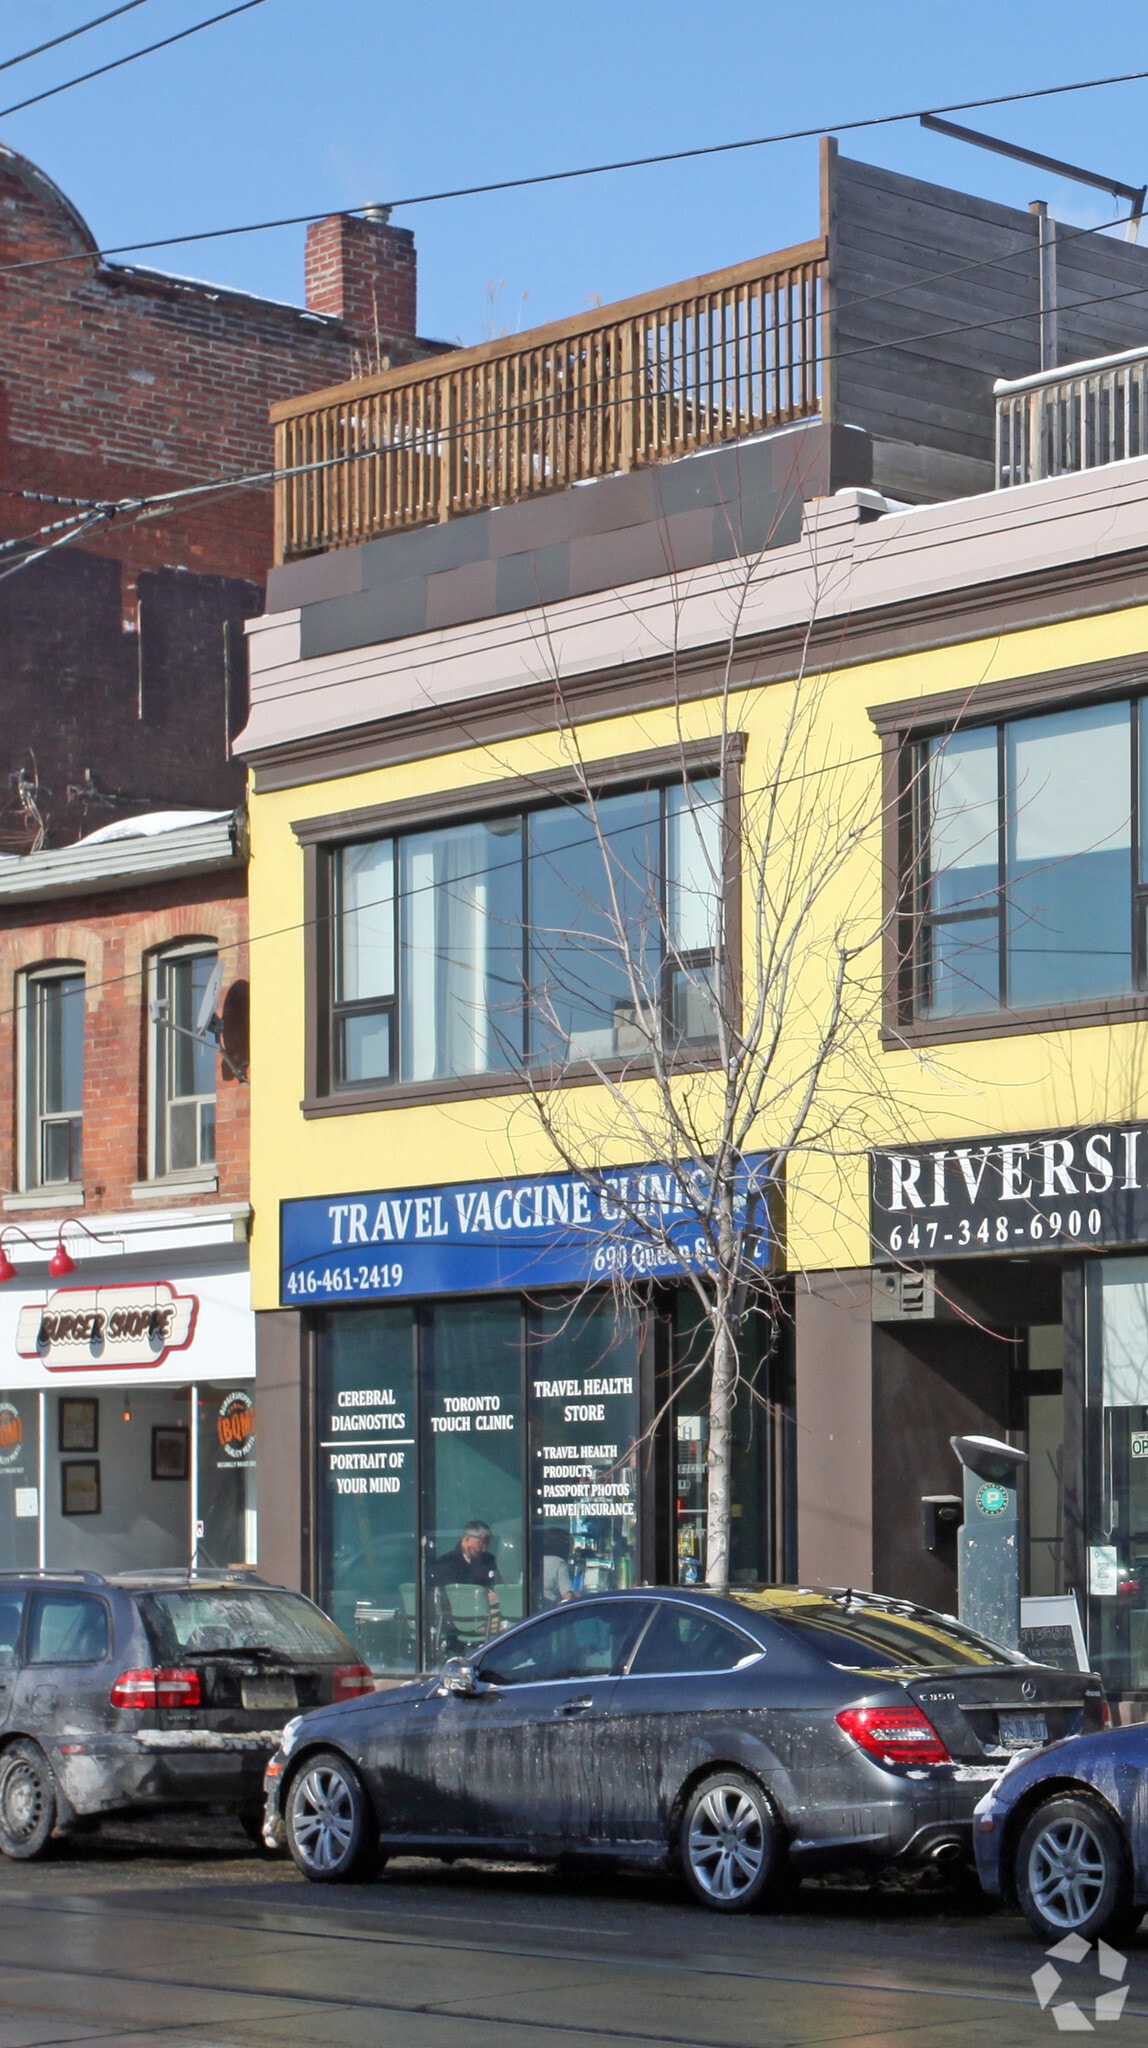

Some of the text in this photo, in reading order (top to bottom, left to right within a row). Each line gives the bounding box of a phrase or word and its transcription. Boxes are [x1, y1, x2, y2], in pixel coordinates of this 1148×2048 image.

[887, 1130, 1148, 1211] RIVERSI
[329, 1197, 449, 1245] TRAVEL
[459, 1181, 592, 1234] VACCINE
[889, 1208, 1102, 1251] 647-348-6900
[594, 1244, 627, 1271] 690
[286, 1264, 403, 1295] 416-461-2419
[41, 1307, 175, 1343] BURGER SHOPPE
[533, 1377, 633, 1398] TRAVEL HEALTH
[337, 1389, 395, 1408] CEREBRAL
[444, 1395, 500, 1413] TORONTO
[564, 1404, 605, 1422] STORE
[331, 1413, 406, 1433] DIAGNOSTICS
[431, 1414, 514, 1433] TOUCH CLINIC
[330, 1452, 405, 1471] PORTRAIT OF
[542, 1445, 618, 1460] TRAVEL HEALTH
[543, 1465, 593, 1479] PRODUCTS
[337, 1477, 400, 1494] YOUR MIND
[543, 1483, 630, 1498] PASSPORT PHOTOS
[543, 1502, 635, 1517] TRAVEL INSURANCE
